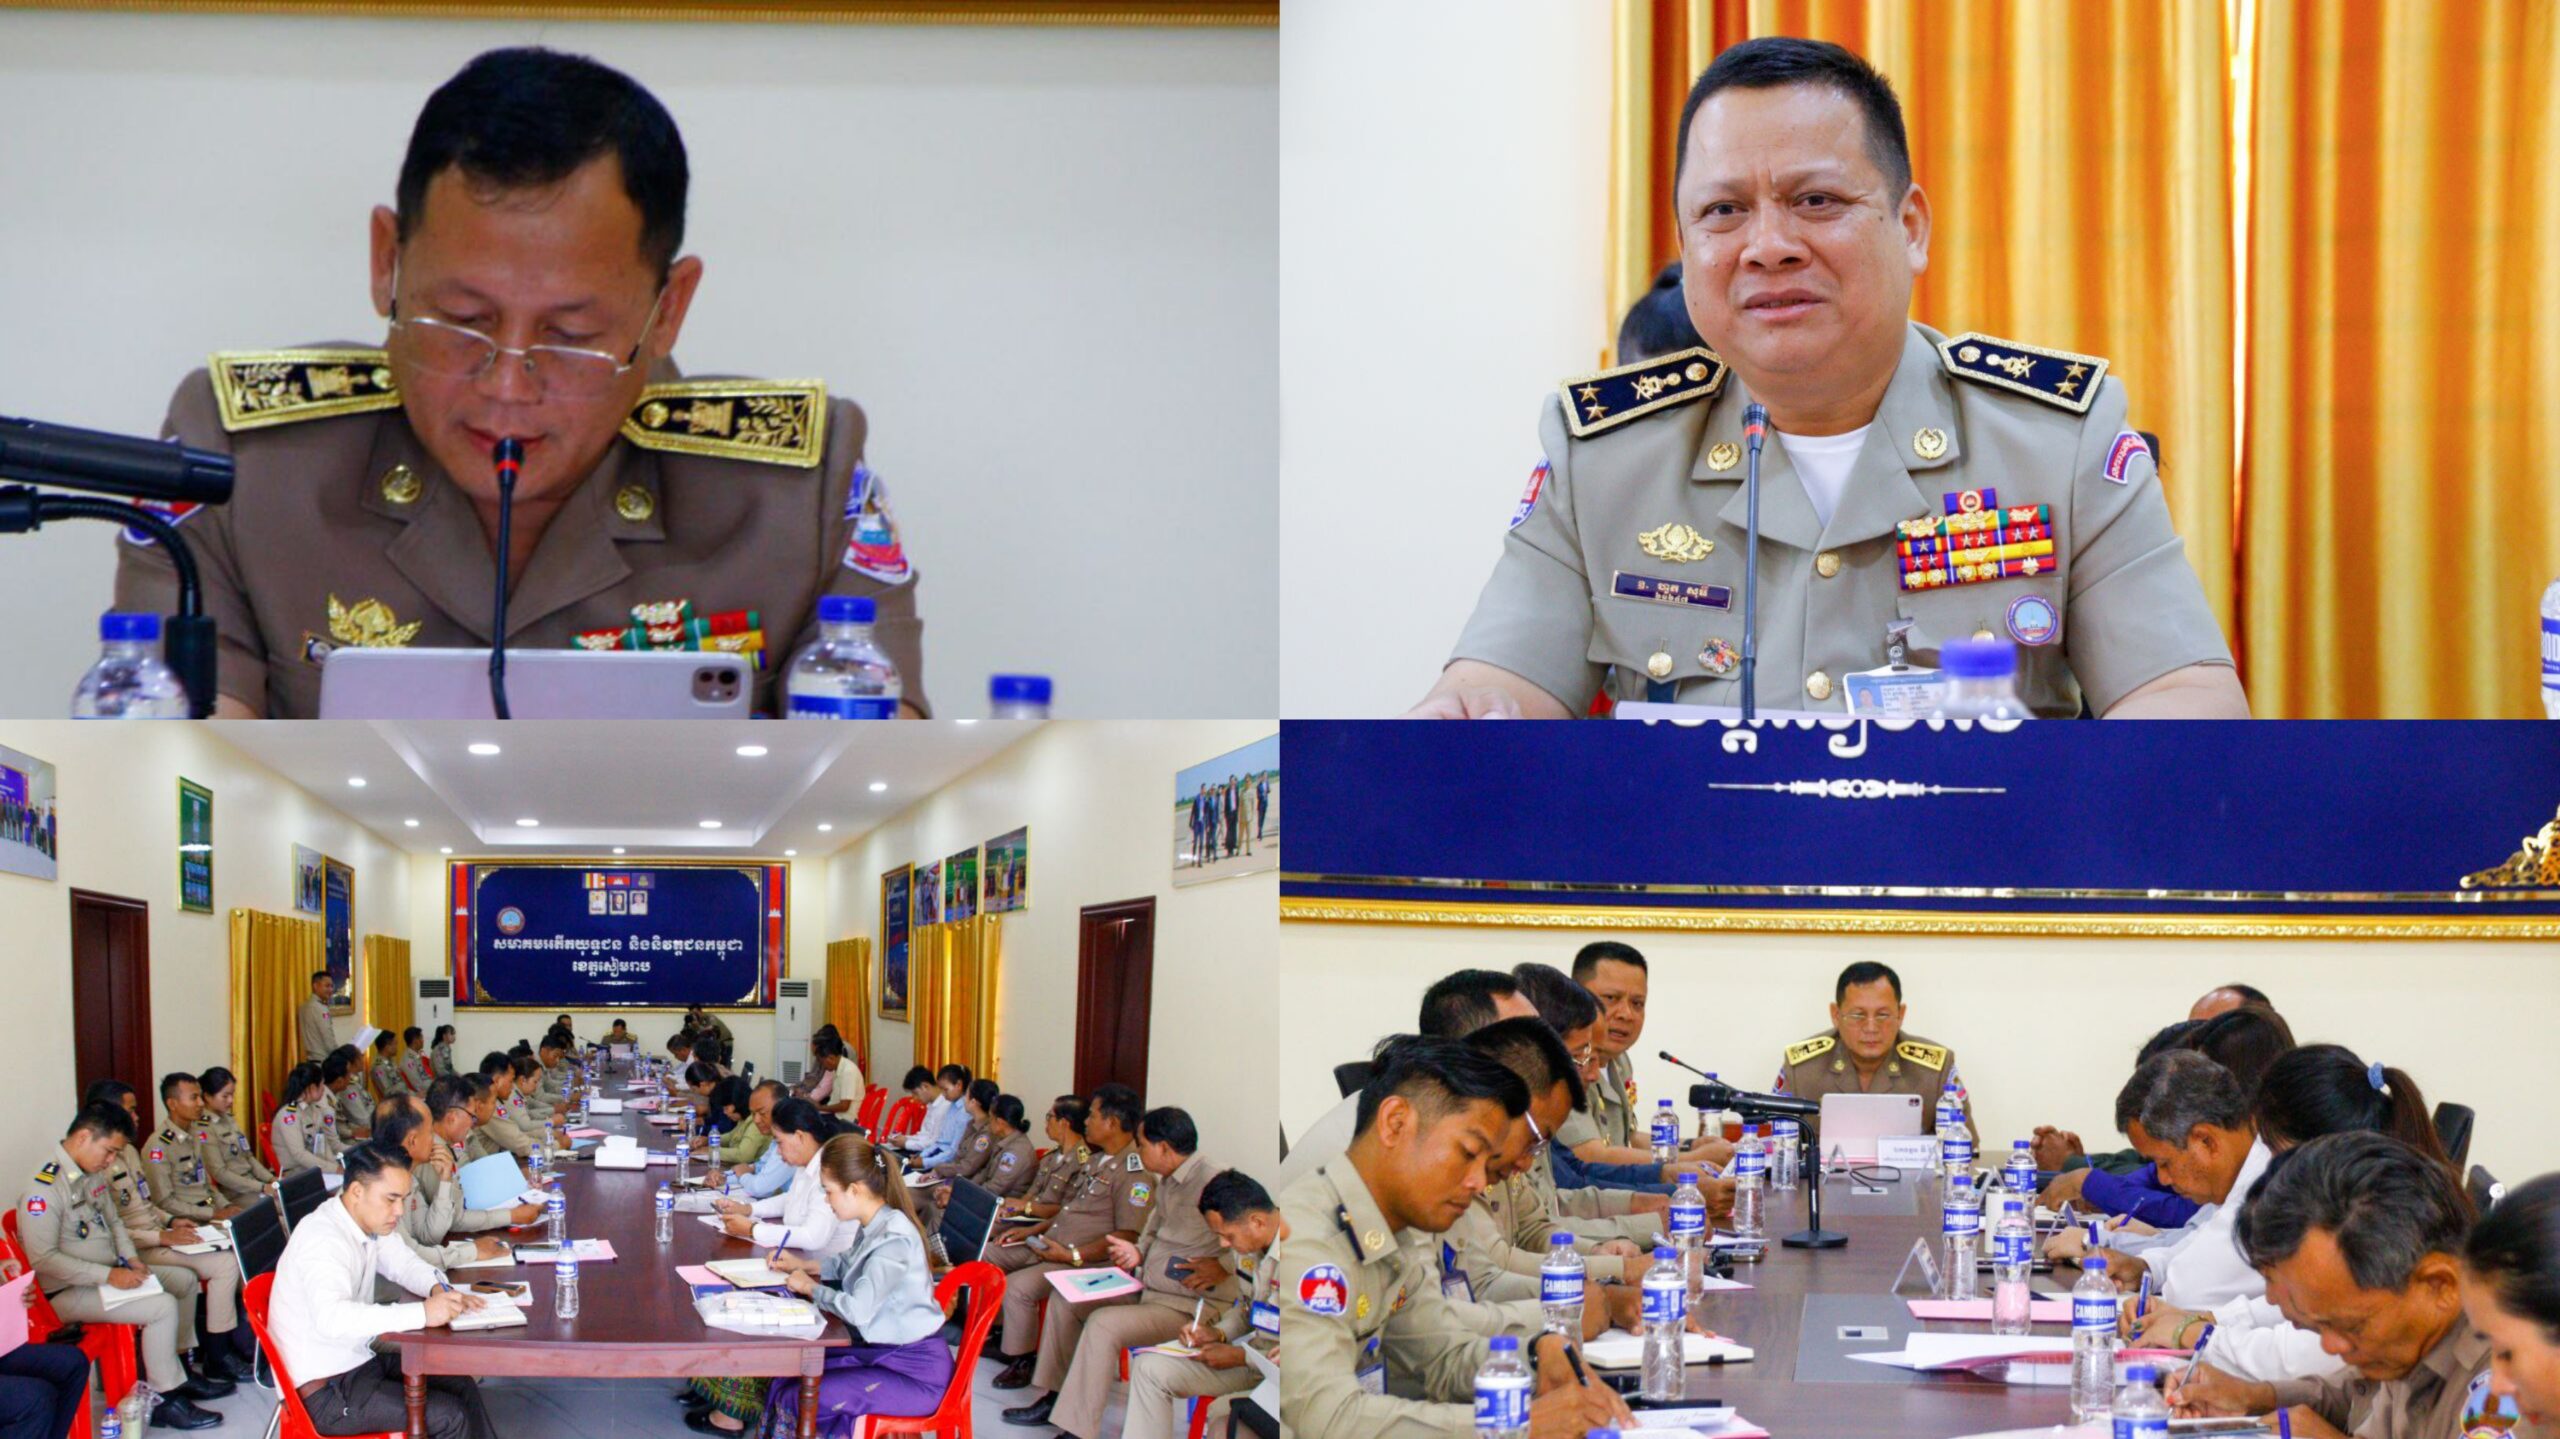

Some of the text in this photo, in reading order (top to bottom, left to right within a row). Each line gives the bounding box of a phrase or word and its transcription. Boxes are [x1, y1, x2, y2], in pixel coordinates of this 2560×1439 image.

[572, 956, 651, 978] ខេត្តសៀមរាប
[2074, 1304, 2115, 1319] CAMBODIA
